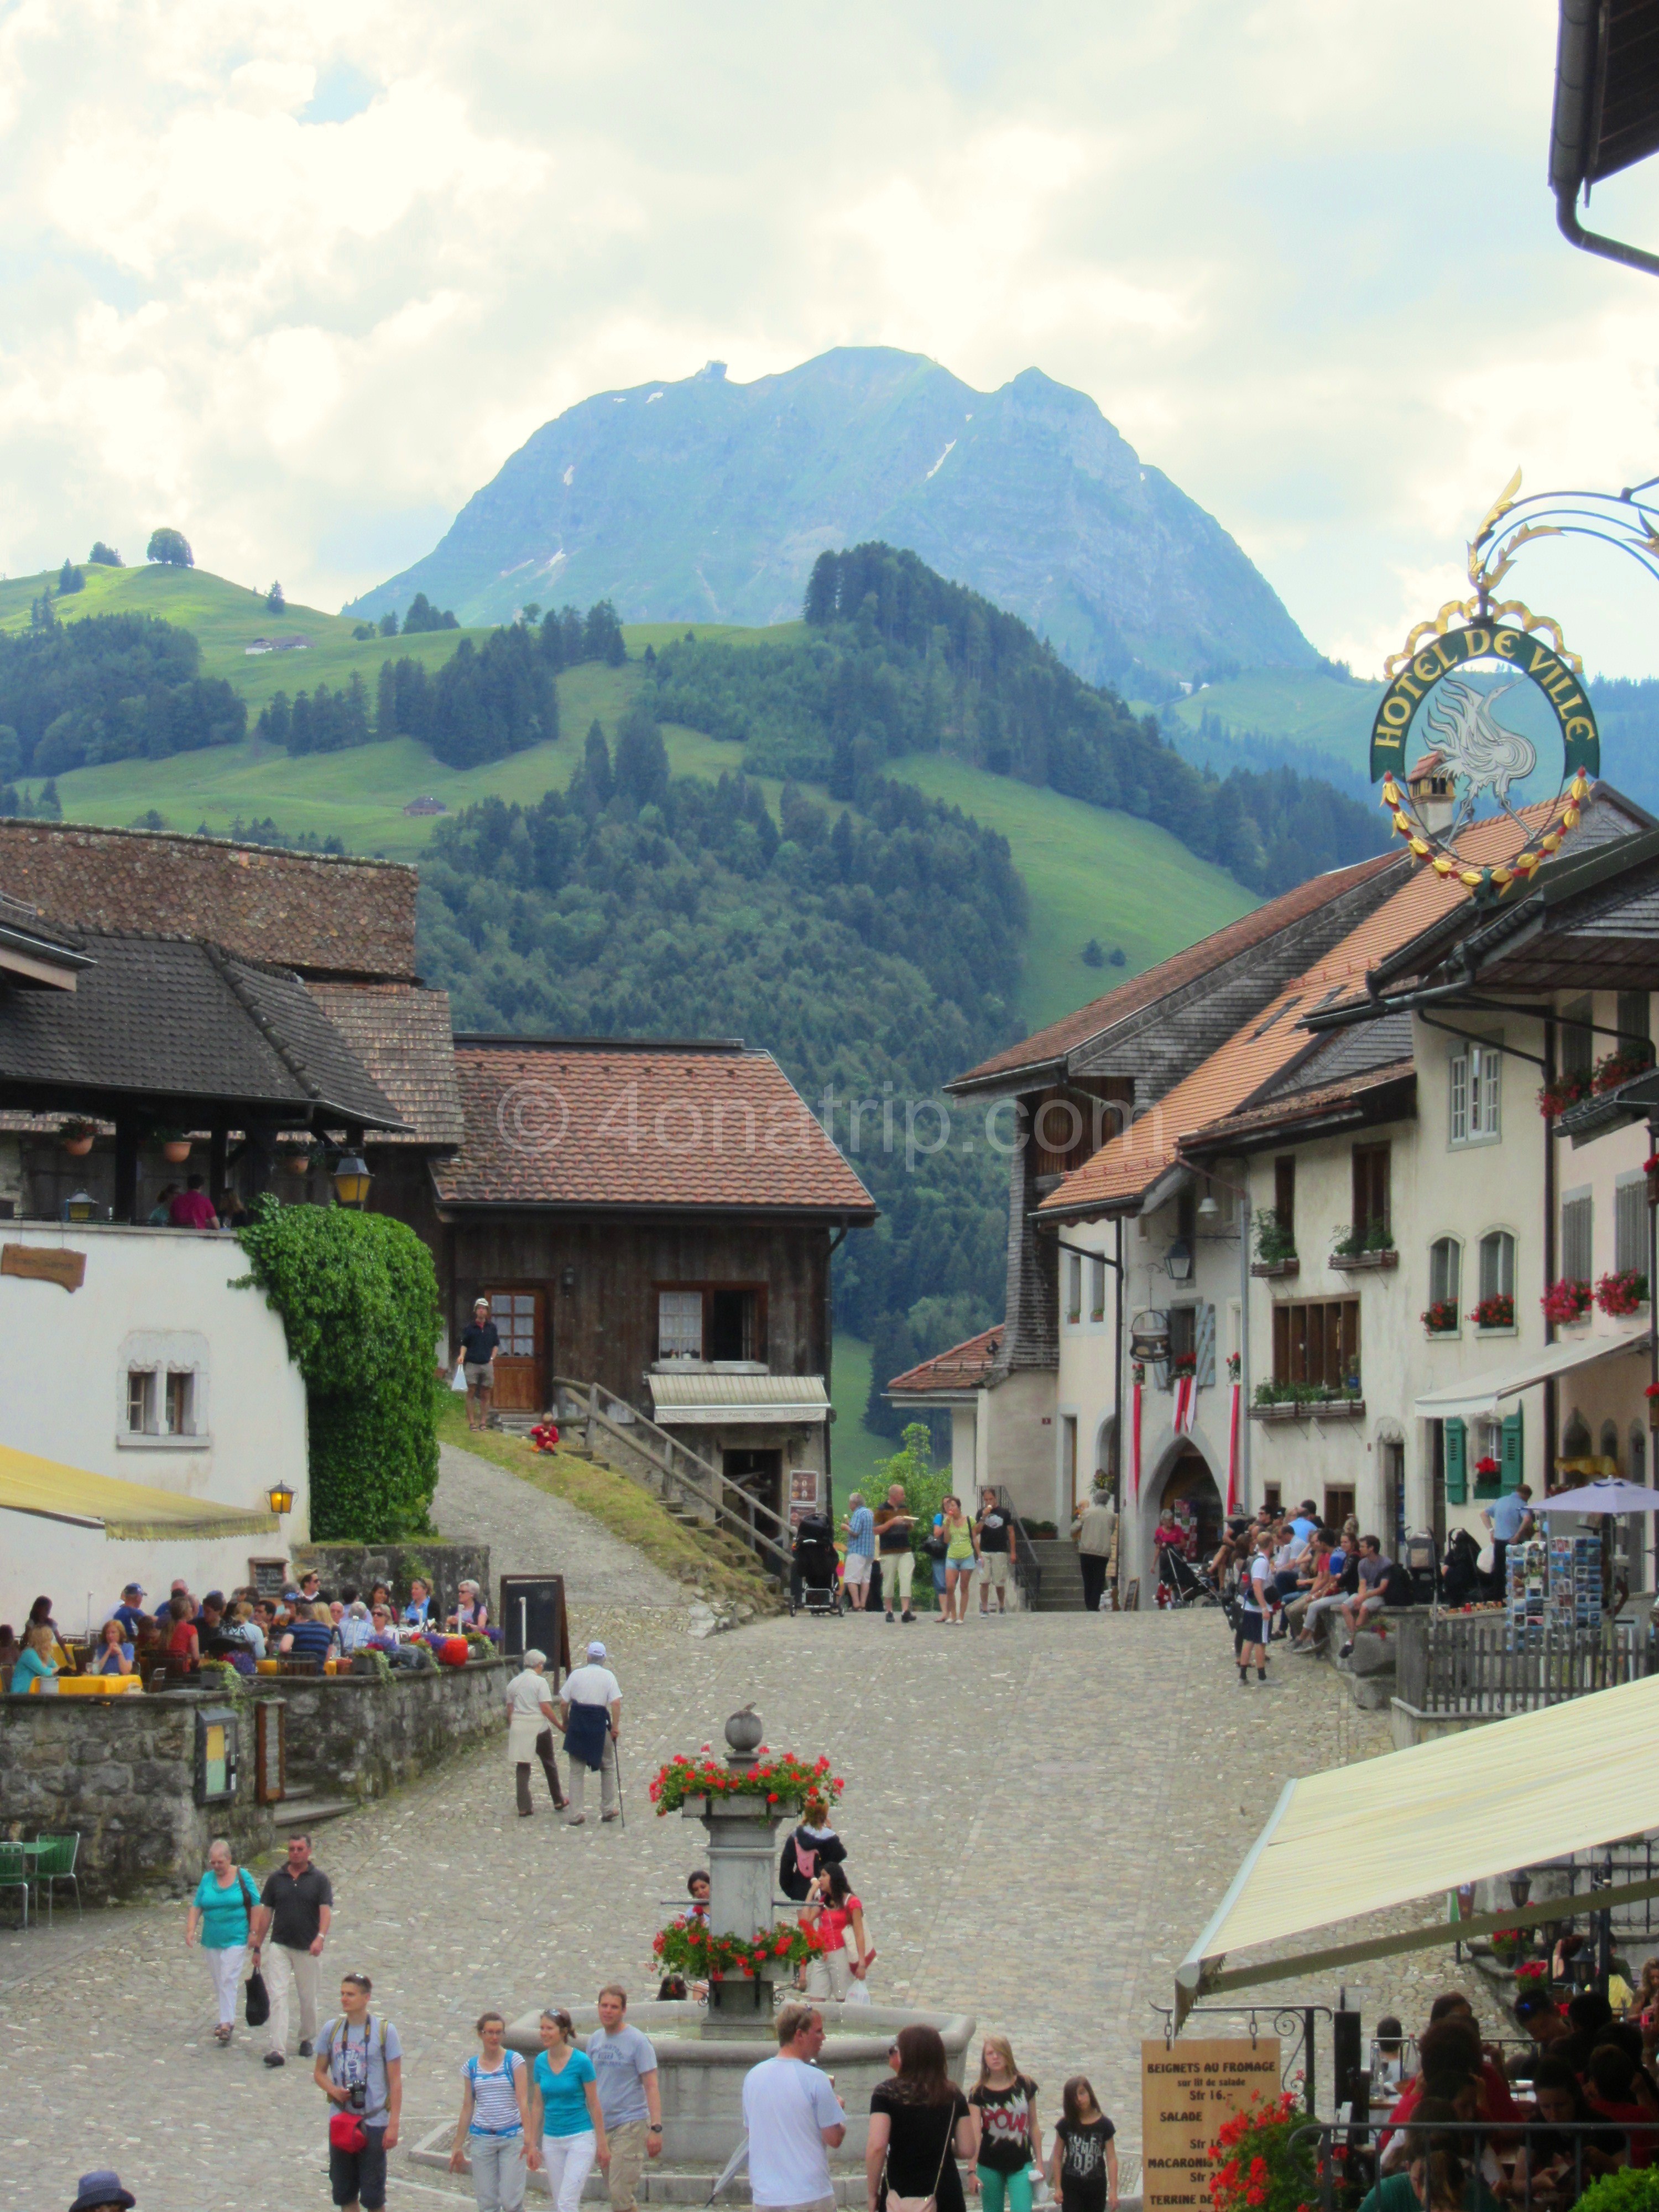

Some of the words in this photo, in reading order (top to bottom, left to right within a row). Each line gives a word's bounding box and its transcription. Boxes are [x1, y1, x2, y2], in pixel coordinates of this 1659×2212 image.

[1375, 644, 1458, 748] HOTEL
[1464, 629, 1520, 658] DE
[1528, 646, 1596, 742] VILLE
[1147, 2063, 1200, 2073] BEIGNETS
[1204, 2062, 1219, 2073] AU
[1223, 2062, 1275, 2072] FROMAGE
[1194, 2078, 1203, 2086] lit
[1206, 2078, 1215, 2086] de
[1219, 2077, 1245, 2086] salade
[1190, 2090, 1205, 2100] Sfr
[1160, 2111, 1202, 2122] SALADE
[1190, 2139, 1206, 2149] Sfr
[1190, 2172, 1206, 2182] Sfr
[1150, 2194, 1196, 2204] TERRINE
[1200, 2194, 1213, 2204] DE
